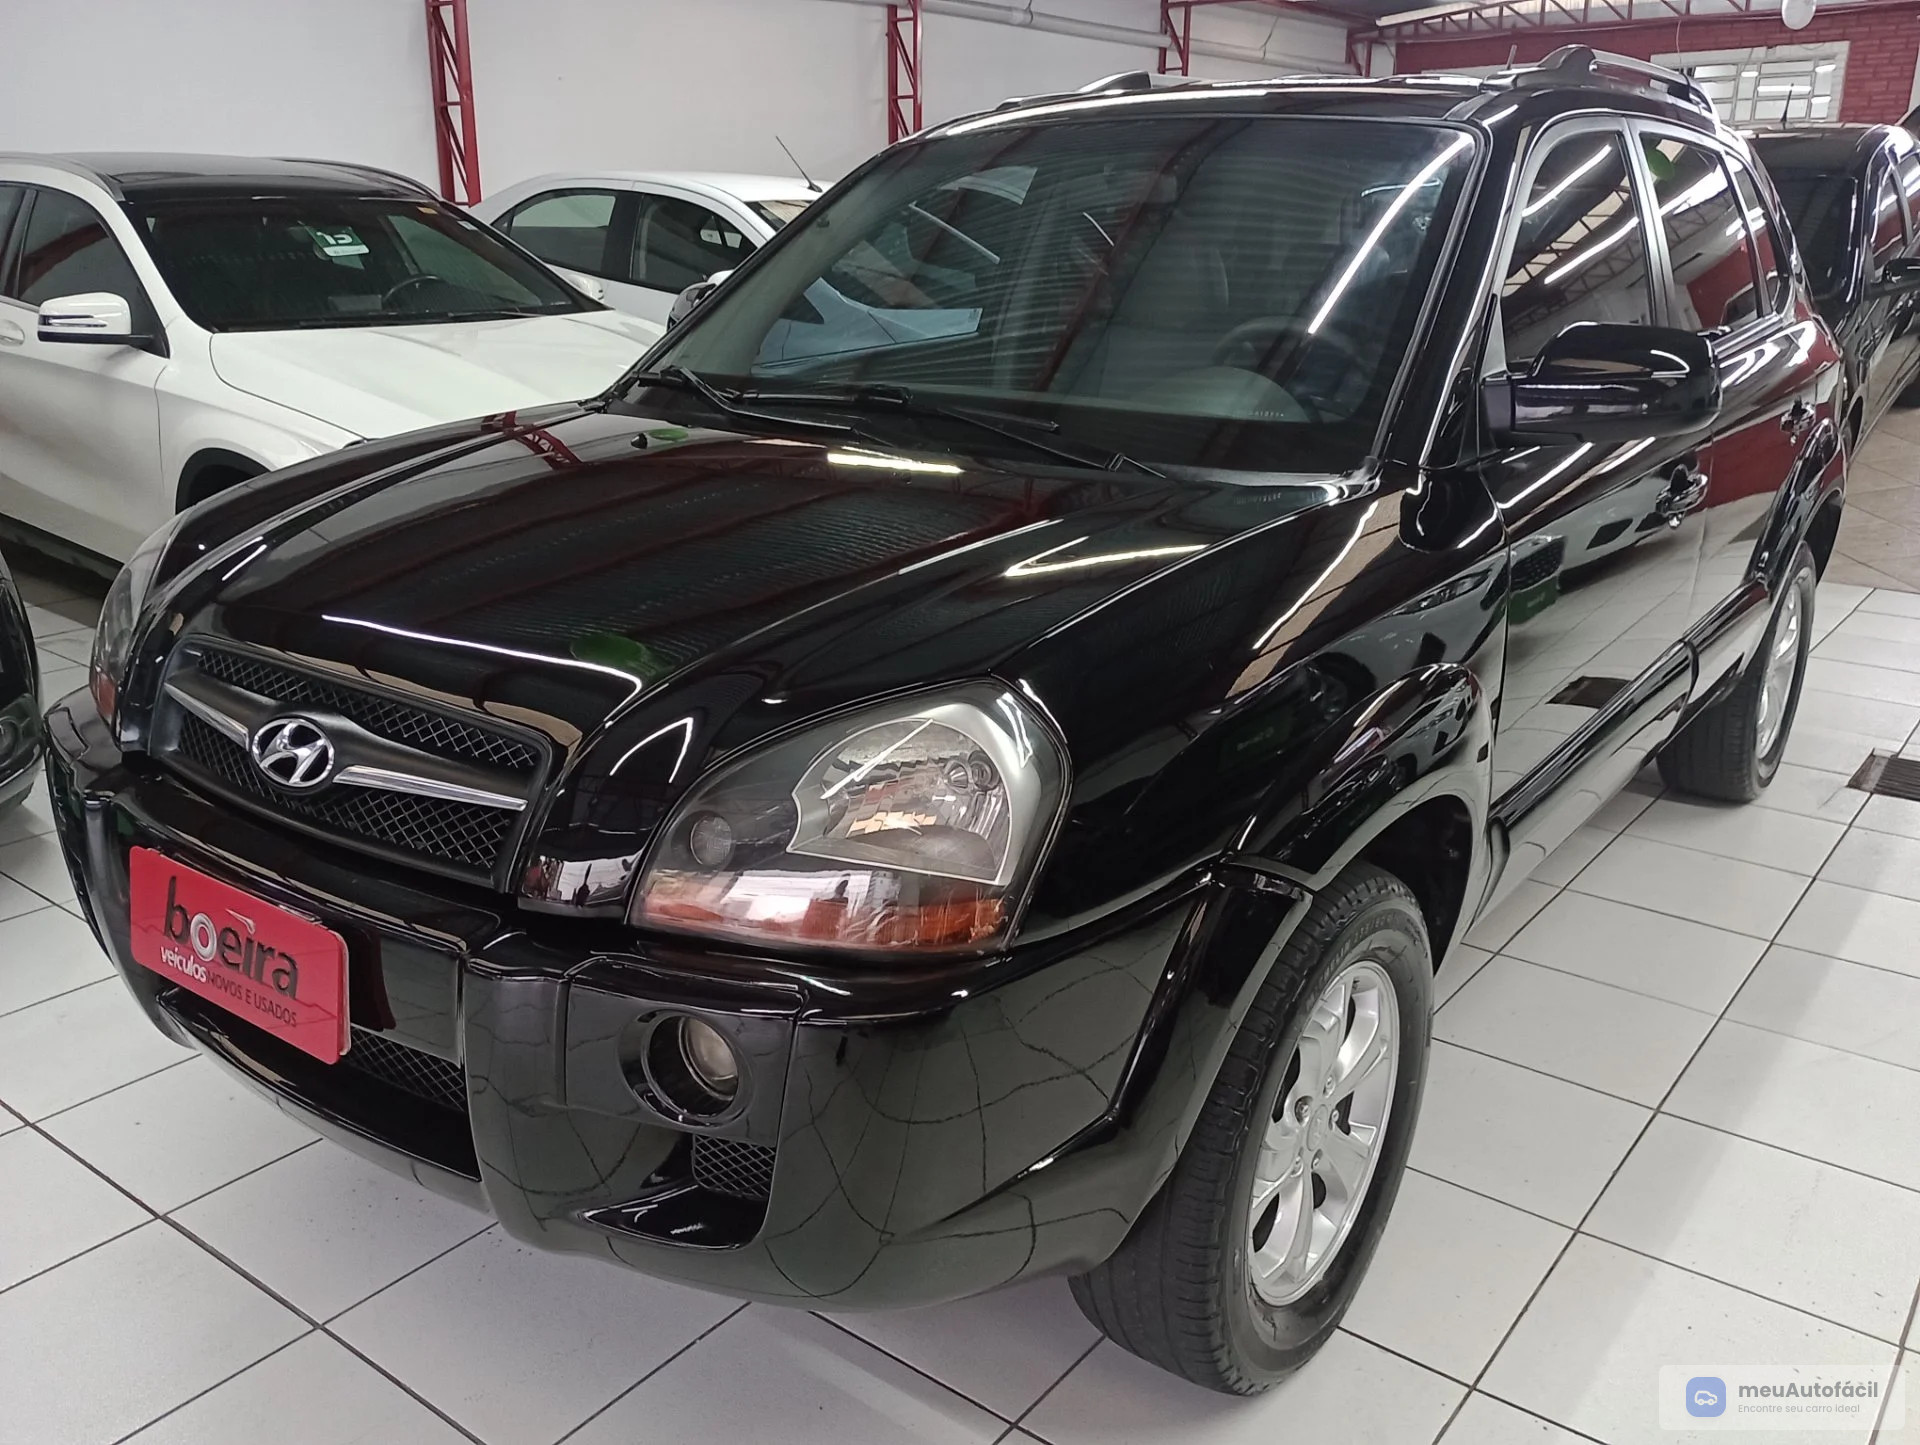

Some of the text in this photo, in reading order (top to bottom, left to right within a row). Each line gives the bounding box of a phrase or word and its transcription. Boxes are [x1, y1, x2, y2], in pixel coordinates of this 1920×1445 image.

[164, 876, 298, 1000] boeira
[207, 971, 242, 1000] NOVOS
[245, 988, 252, 1005] E
[254, 992, 297, 1027] USADOS
